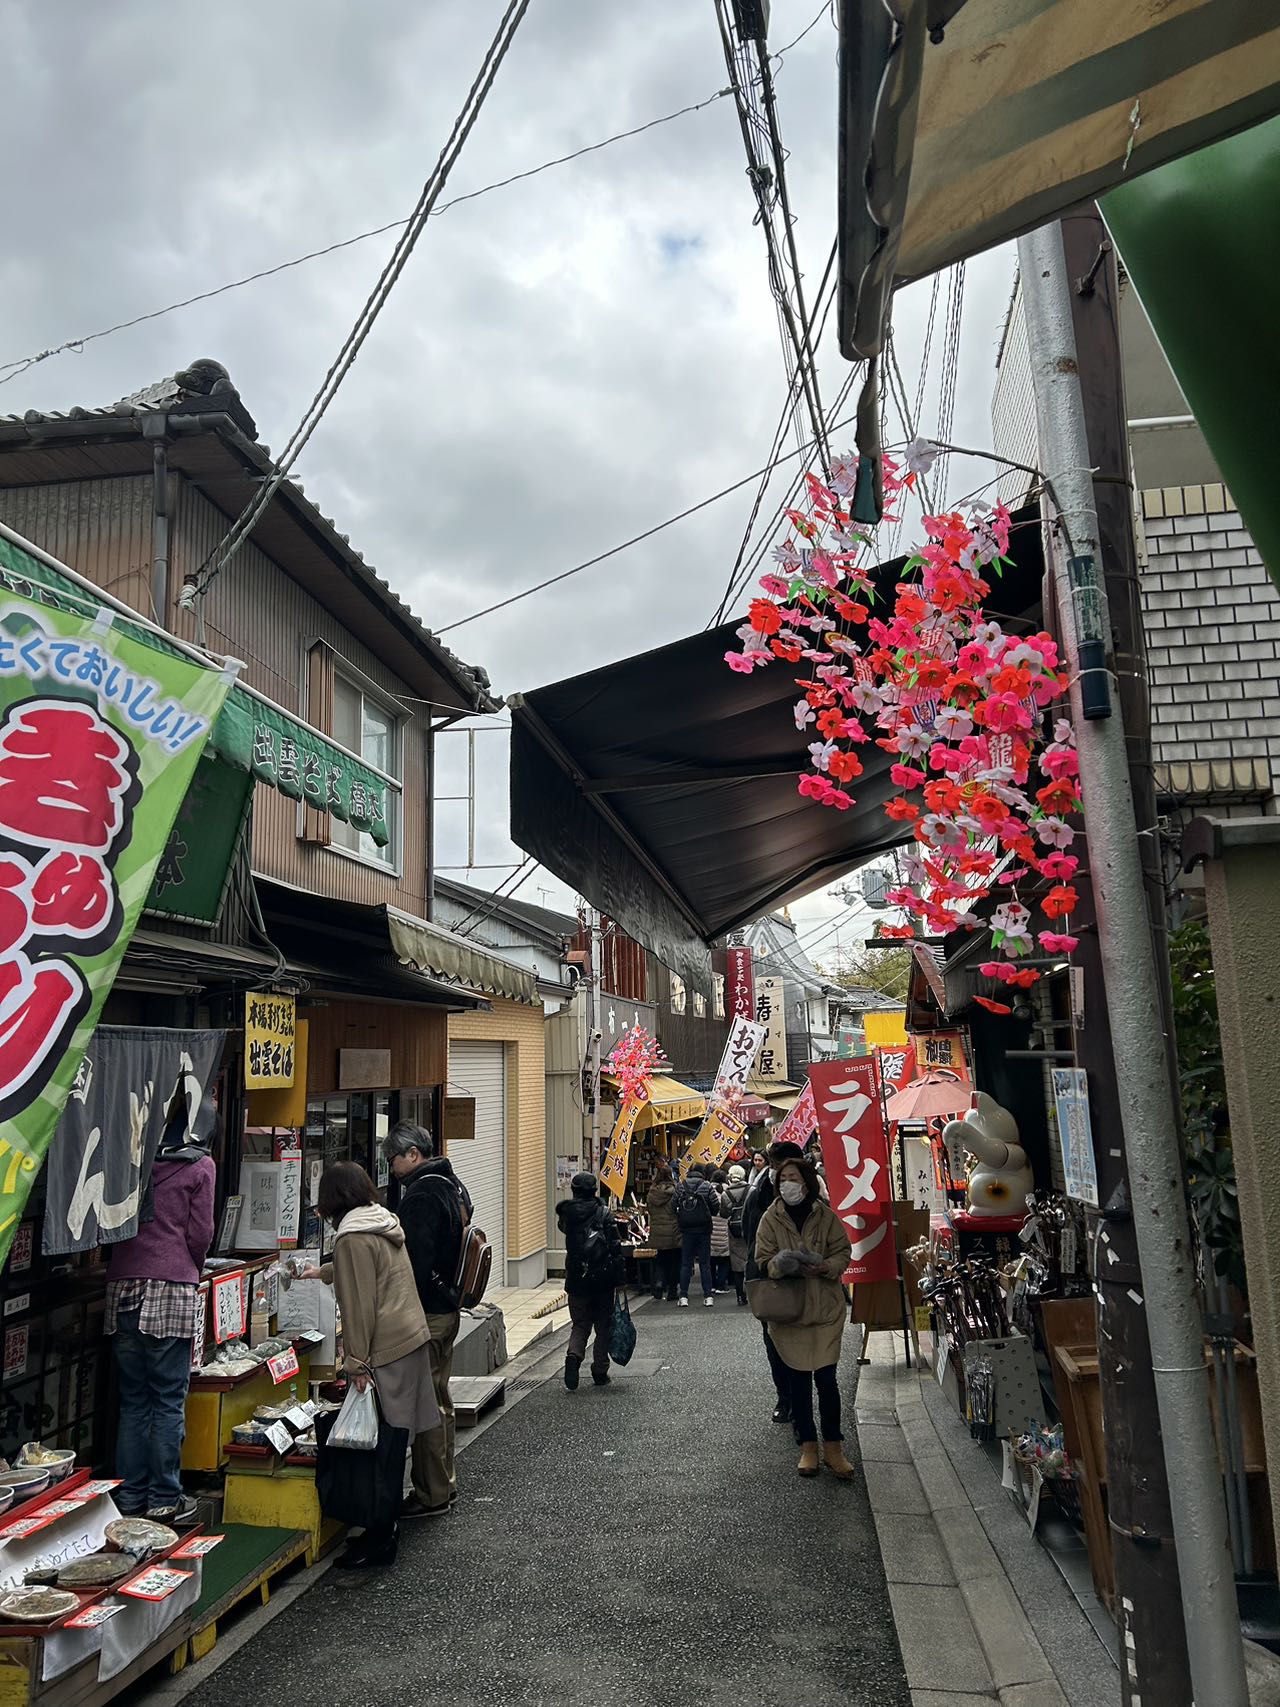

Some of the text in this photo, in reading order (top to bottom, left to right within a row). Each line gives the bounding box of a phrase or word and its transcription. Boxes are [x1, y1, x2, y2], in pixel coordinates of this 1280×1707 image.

[253, 724, 385, 827] 出雲そば 橋本
[249, 1039, 294, 1078] 出雲そば
[279, 1160, 297, 1238] 手打うどんの味
[823, 1079, 889, 1262] ラーメン
